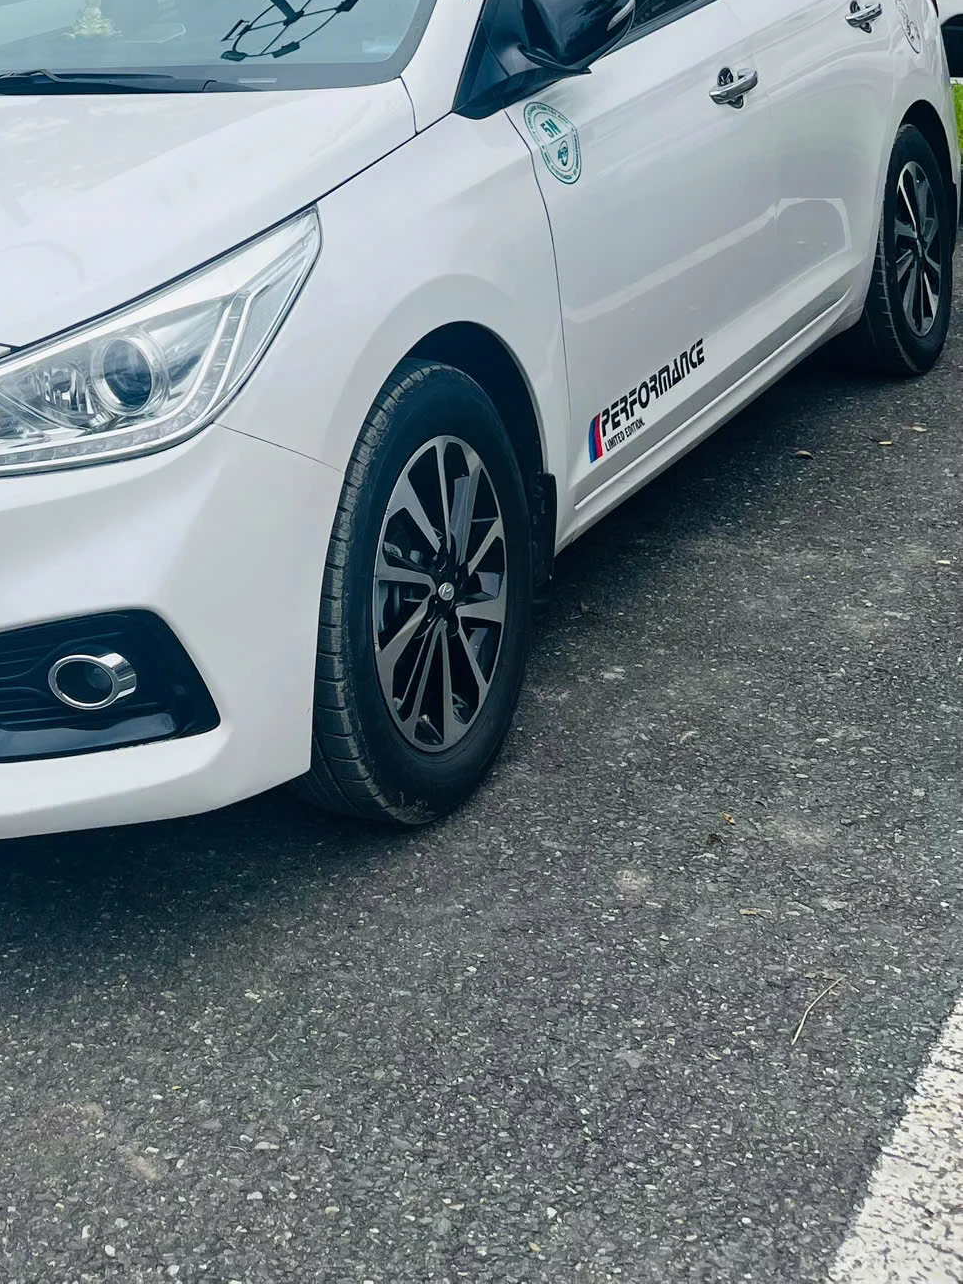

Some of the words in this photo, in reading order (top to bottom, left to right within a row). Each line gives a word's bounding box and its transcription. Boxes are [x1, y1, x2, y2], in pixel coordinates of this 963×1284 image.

[601, 338, 705, 437] PERFORMANCE
[604, 431, 625, 451] LIMITED
[624, 417, 645, 437] EDITION
